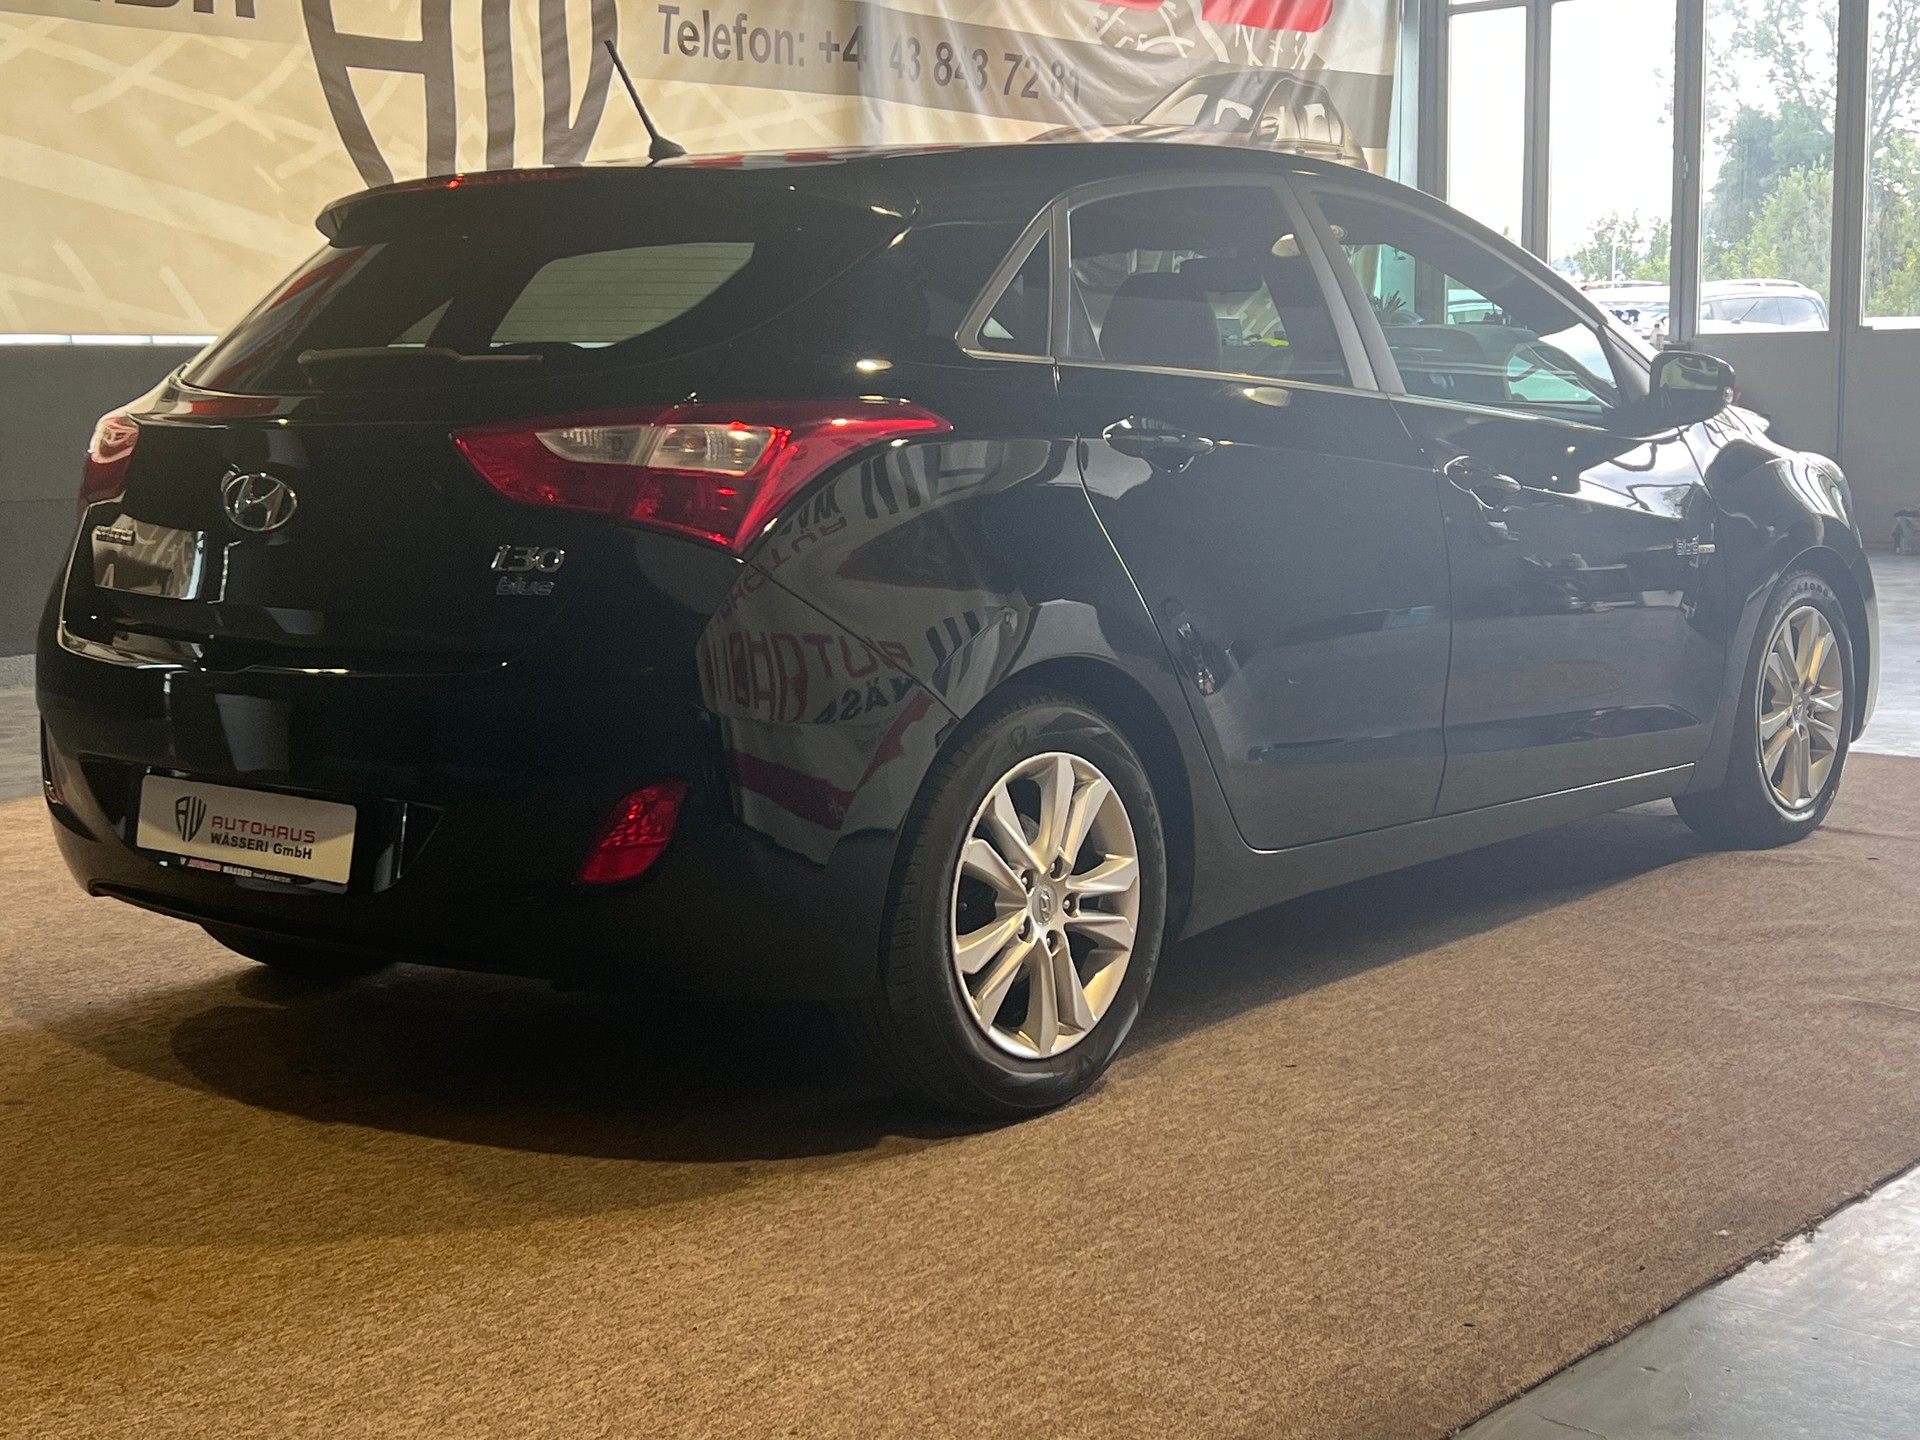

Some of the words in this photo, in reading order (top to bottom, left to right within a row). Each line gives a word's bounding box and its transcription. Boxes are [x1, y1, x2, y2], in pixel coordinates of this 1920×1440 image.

[658, 4, 805, 68] Telefon:
[818, 25, 868, 72] +4
[888, 33, 921, 83] 43
[933, 41, 990, 93] 843
[1003, 53, 1041, 100] 72
[491, 544, 566, 572] i30
[211, 815, 316, 844] AUTOHAUS
[210, 832, 269, 854] WÄSSERI
[273, 842, 313, 860] GmbH
